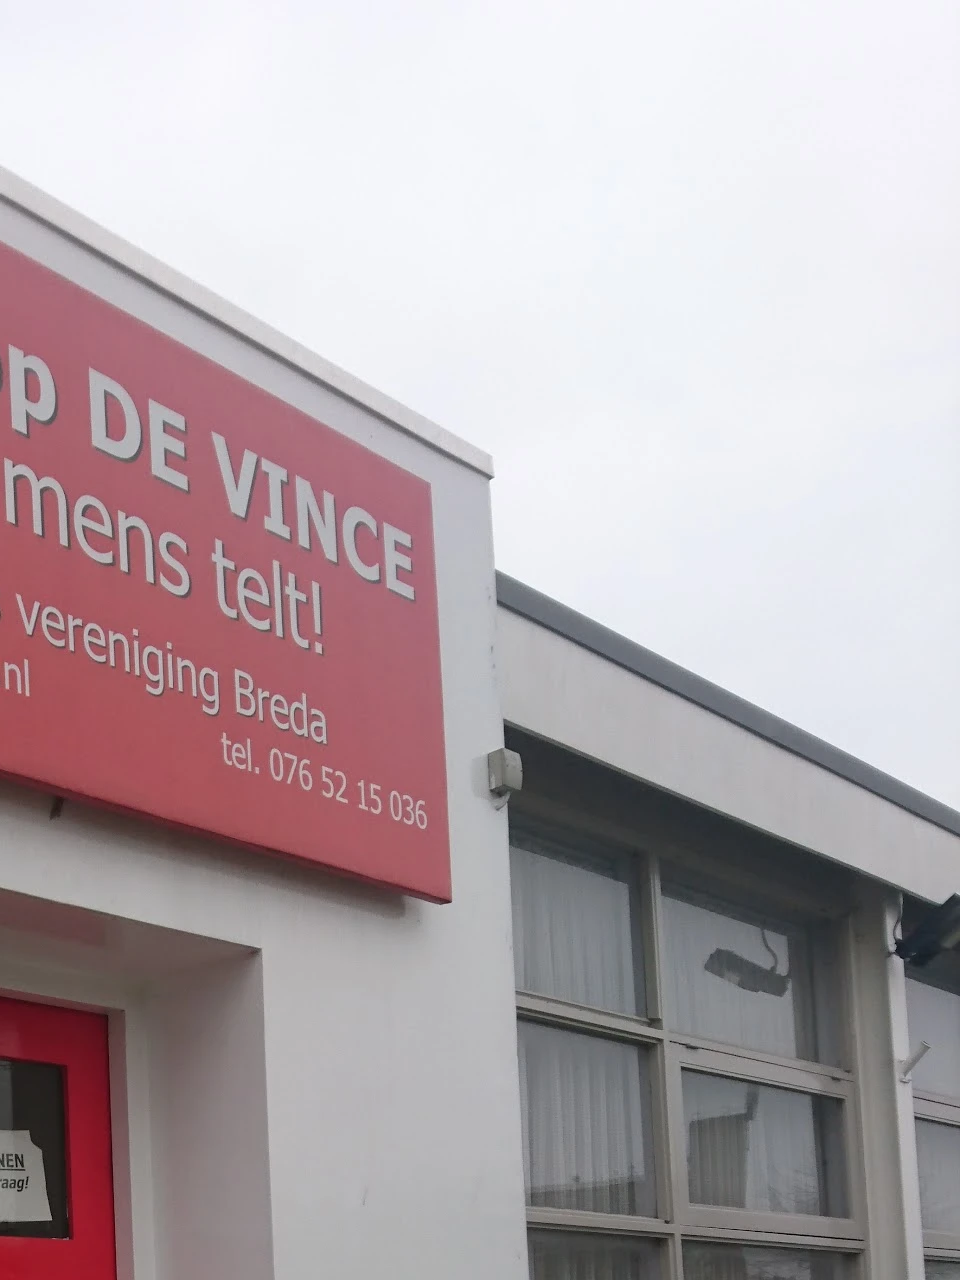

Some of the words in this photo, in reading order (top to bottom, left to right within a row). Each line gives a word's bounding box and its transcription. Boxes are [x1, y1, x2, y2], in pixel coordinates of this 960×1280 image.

[4, 457, 191, 598] mens
[212, 538, 324, 655] telt!
[88, 367, 190, 491] DE
[211, 431, 416, 600] VINCE
[16, 593, 220, 715] vereniging
[235, 669, 328, 744] Breda
[221, 732, 260, 774] tel.
[270, 748, 313, 790] 076
[321, 766, 349, 803] 52
[357, 780, 382, 814] 15
[390, 790, 428, 829] 036
